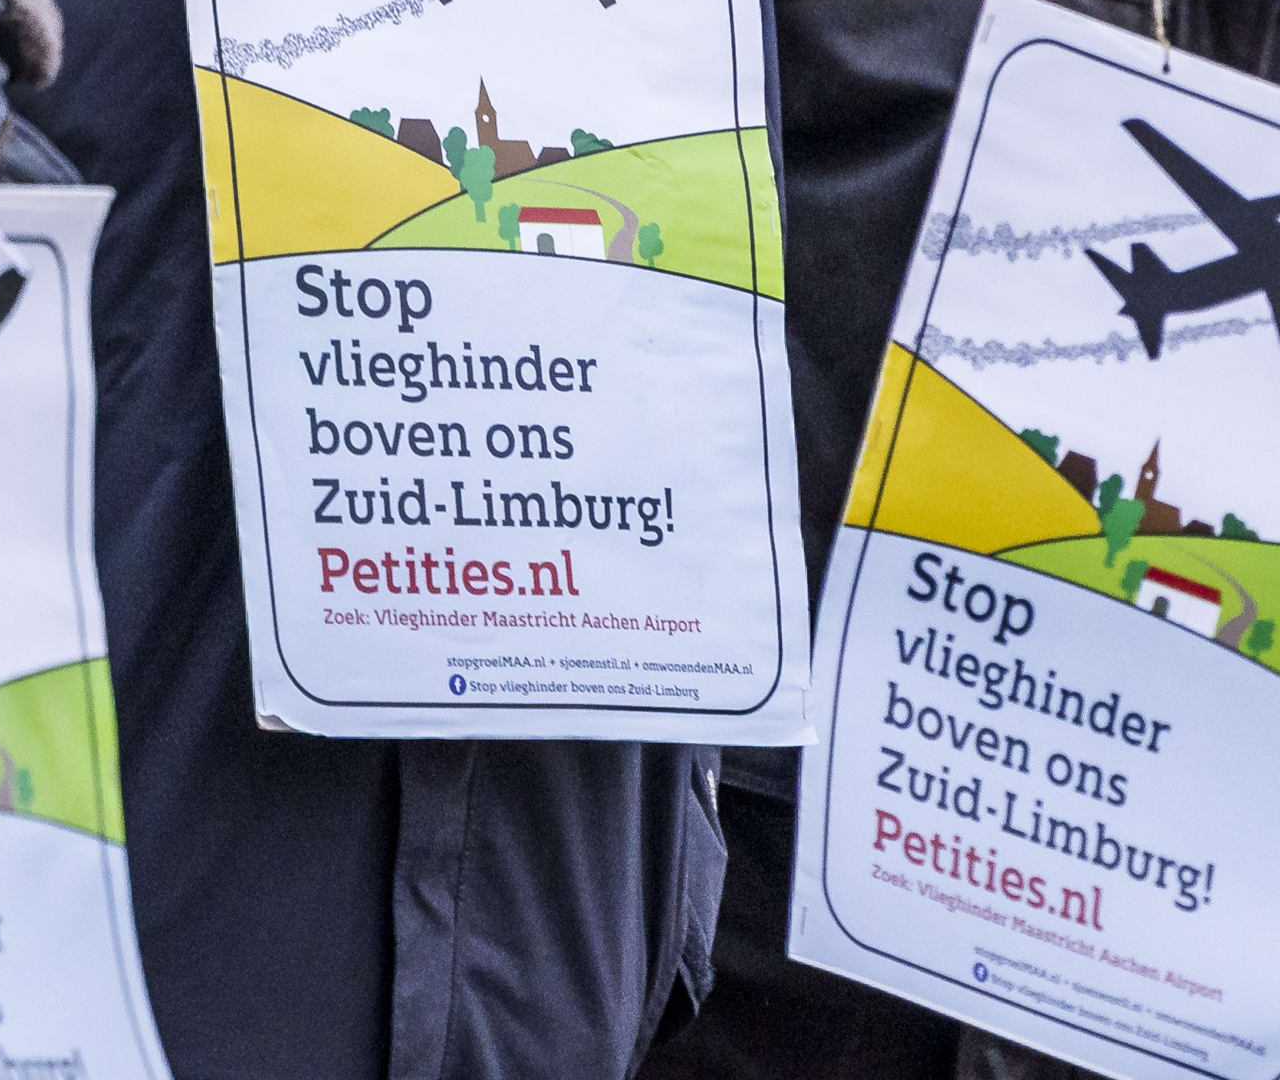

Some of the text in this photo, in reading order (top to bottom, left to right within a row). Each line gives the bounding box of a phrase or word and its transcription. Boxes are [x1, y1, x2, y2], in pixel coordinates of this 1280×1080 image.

[295, 264, 432, 333] Stop
[298, 338, 597, 403] vlieghinder
[305, 407, 573, 459] boven ons
[312, 477, 673, 547] Zuid-Limburg!
[317, 546, 579, 595] Petities.nl
[907, 552, 1034, 645] Stop
[323, 608, 700, 635] Zoek: Vlieghinder Maastricht Aachen Airport
[446, 656, 546, 670] stopgroeiMAA.nl
[559, 659, 630, 670] sjoenenstil.nl
[641, 661, 752, 674] omwonendenMAA.nl
[469, 680, 497, 694] Stop
[499, 681, 567, 695] vlieghinder
[570, 681, 605, 693] boven
[607, 684, 626, 694] ons
[628, 683, 699, 701] Zuid-Limburg
[896, 629, 1171, 753] vlieghinder
[884, 681, 1127, 807] boven ons
[877, 746, 1214, 912] Zuid-Limburg!
[873, 809, 1102, 931] Petities.nl
